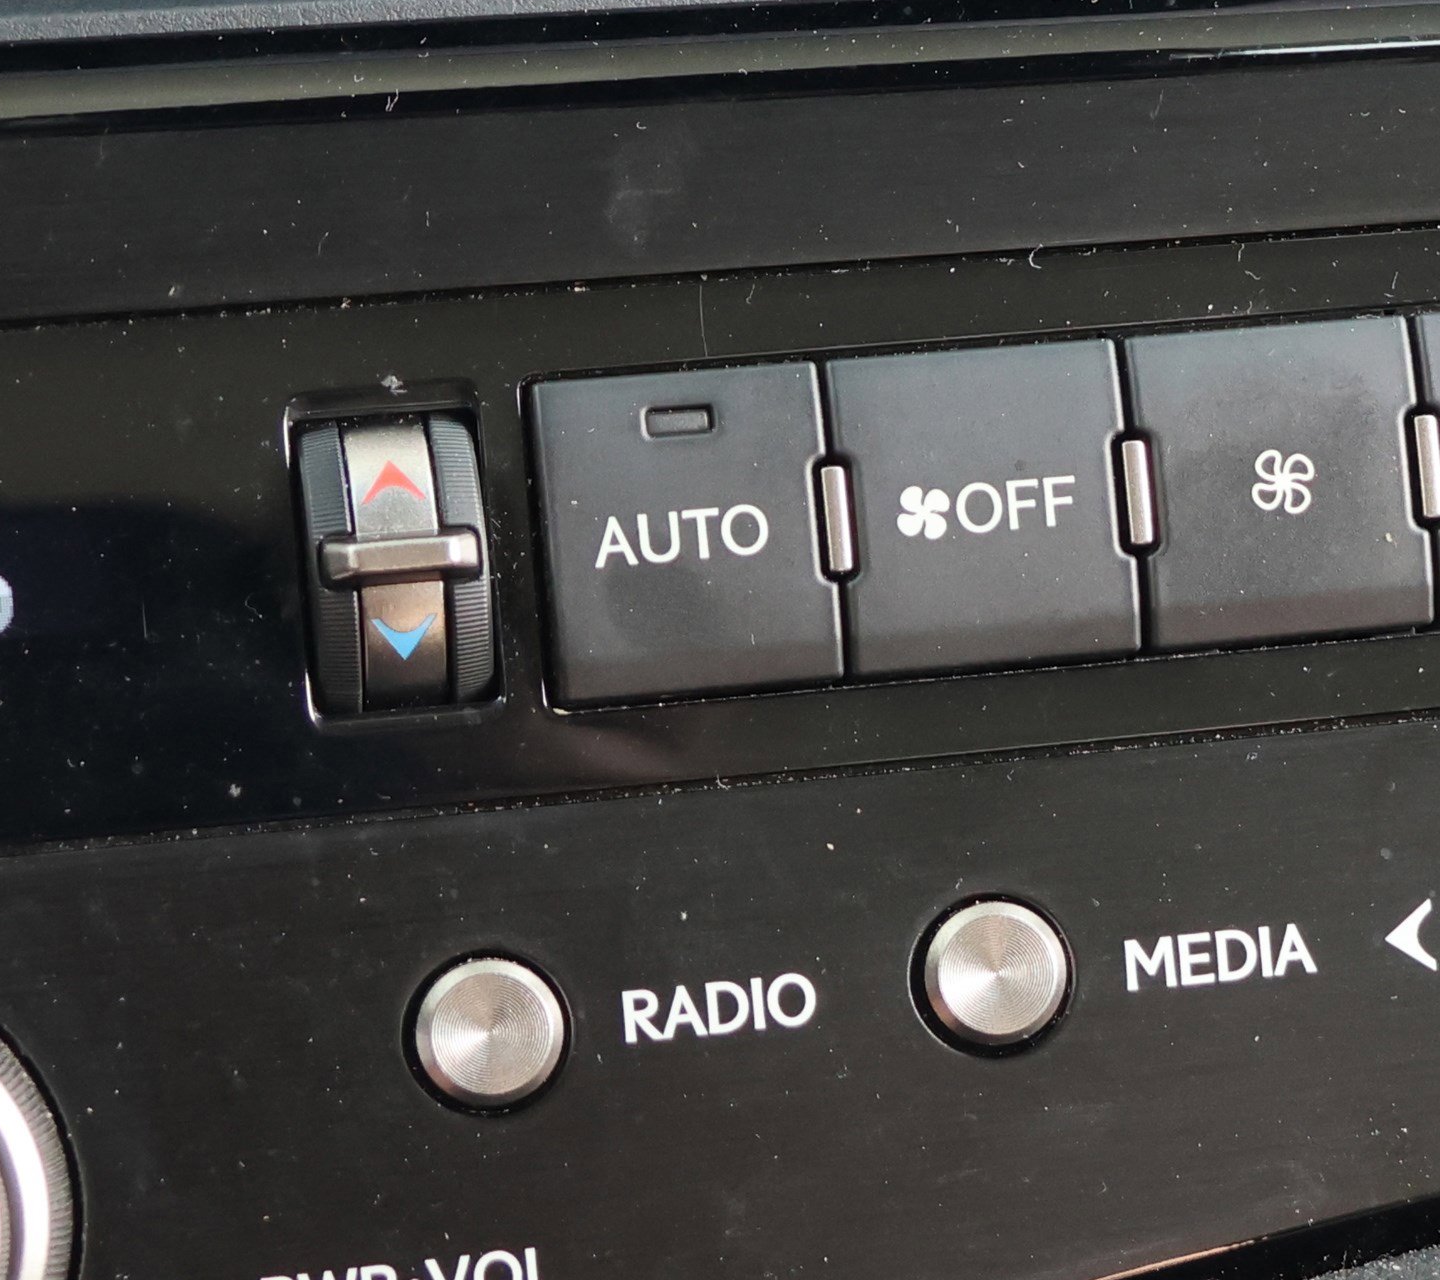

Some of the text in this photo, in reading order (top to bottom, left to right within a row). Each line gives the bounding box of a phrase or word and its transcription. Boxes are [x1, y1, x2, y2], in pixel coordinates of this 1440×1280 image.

[595, 504, 769, 569] AUTO
[956, 475, 1076, 534] OFF
[1124, 923, 1318, 992] MEDIA
[621, 972, 817, 1044] RADIO
